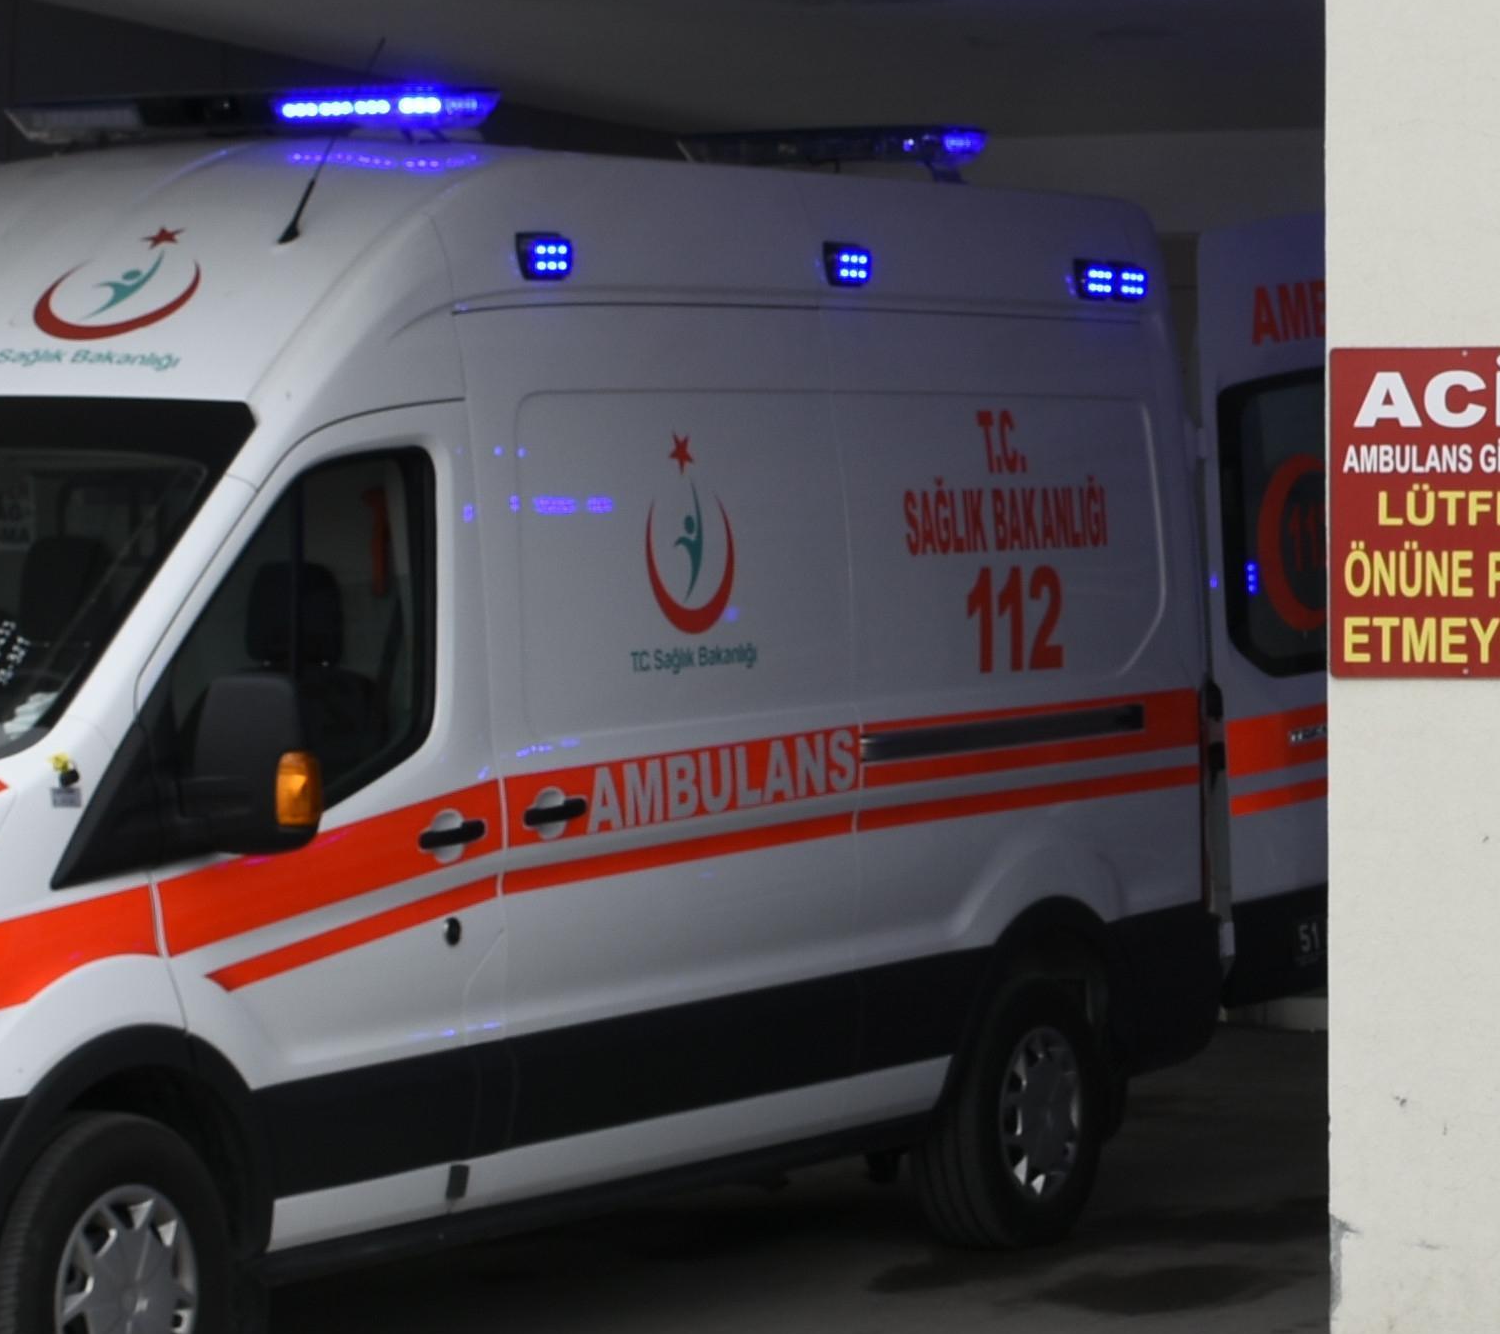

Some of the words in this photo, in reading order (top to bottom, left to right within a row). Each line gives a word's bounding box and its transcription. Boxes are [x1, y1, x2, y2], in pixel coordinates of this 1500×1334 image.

[976, 410, 1028, 474] T.C.
[1343, 444, 1473, 473] AMBULANS
[904, 476, 988, 556] SAĞLIK
[992, 475, 1108, 552] BAKANLIĞI
[1344, 540, 1474, 598] ÖNÜNE
[967, 565, 1065, 673] 112
[587, 729, 857, 835] AMBULANS
